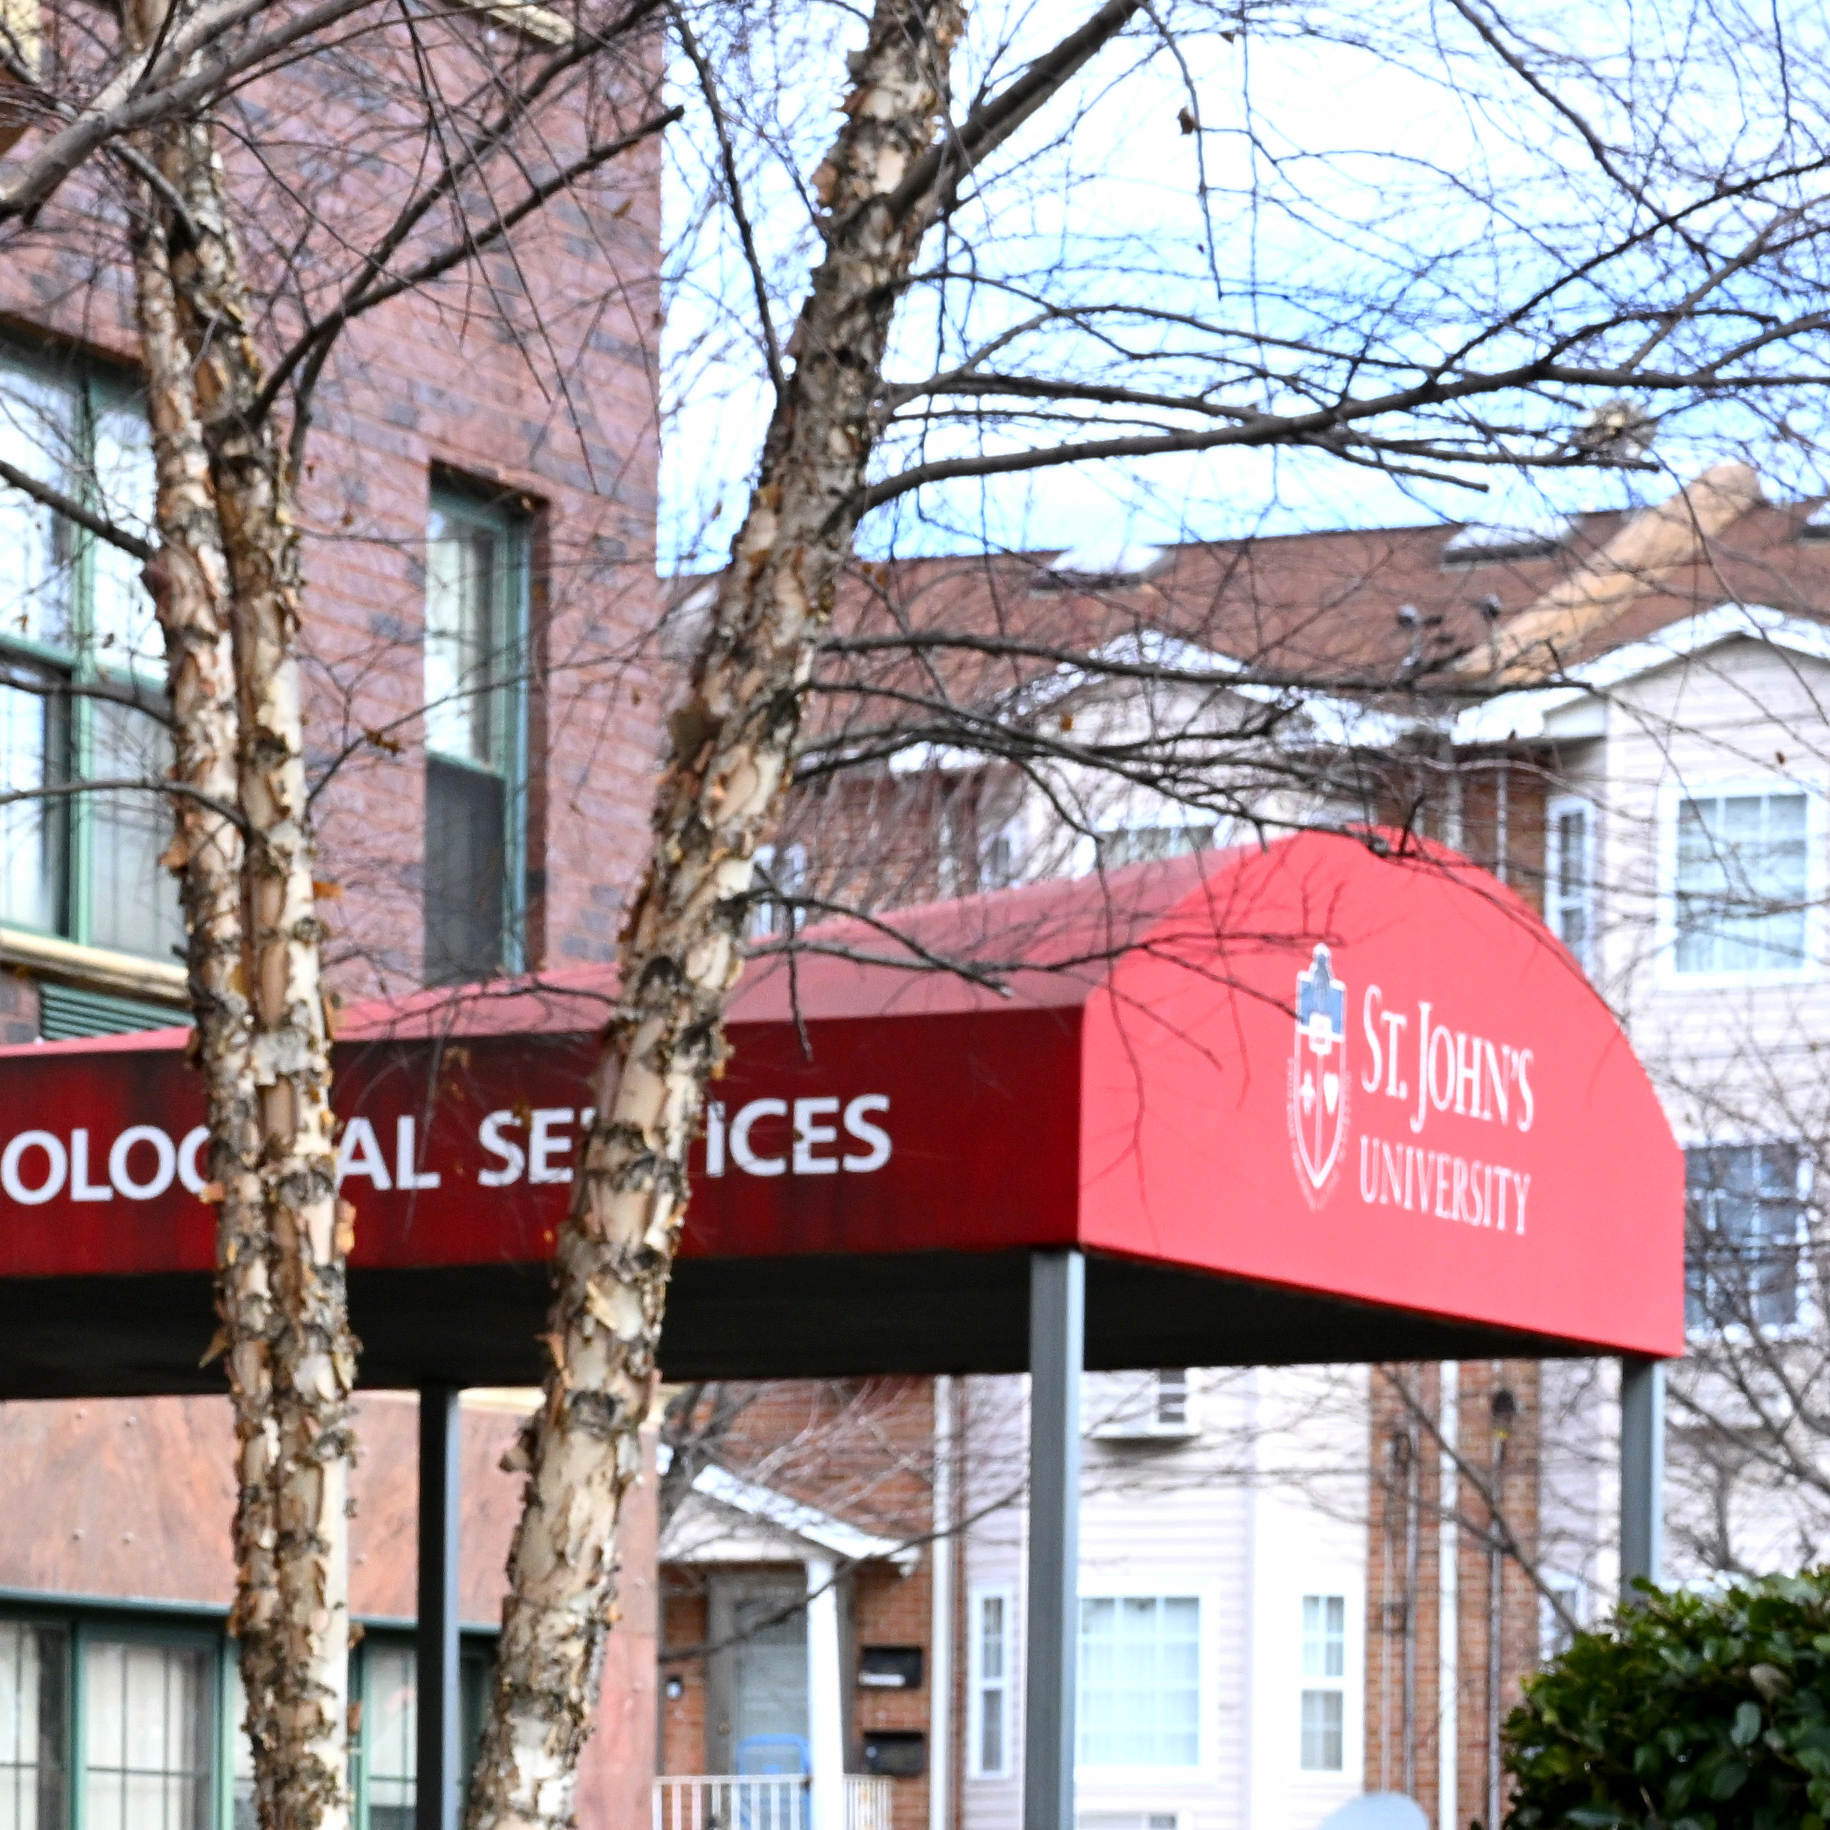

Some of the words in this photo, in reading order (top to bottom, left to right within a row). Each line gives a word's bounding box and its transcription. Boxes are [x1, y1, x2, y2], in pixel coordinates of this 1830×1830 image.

[1409, 999, 1535, 1134] JOHN'S
[477, 1093, 894, 1190] SEICES
[1359, 1134, 1532, 1236] UNIVERSITY
